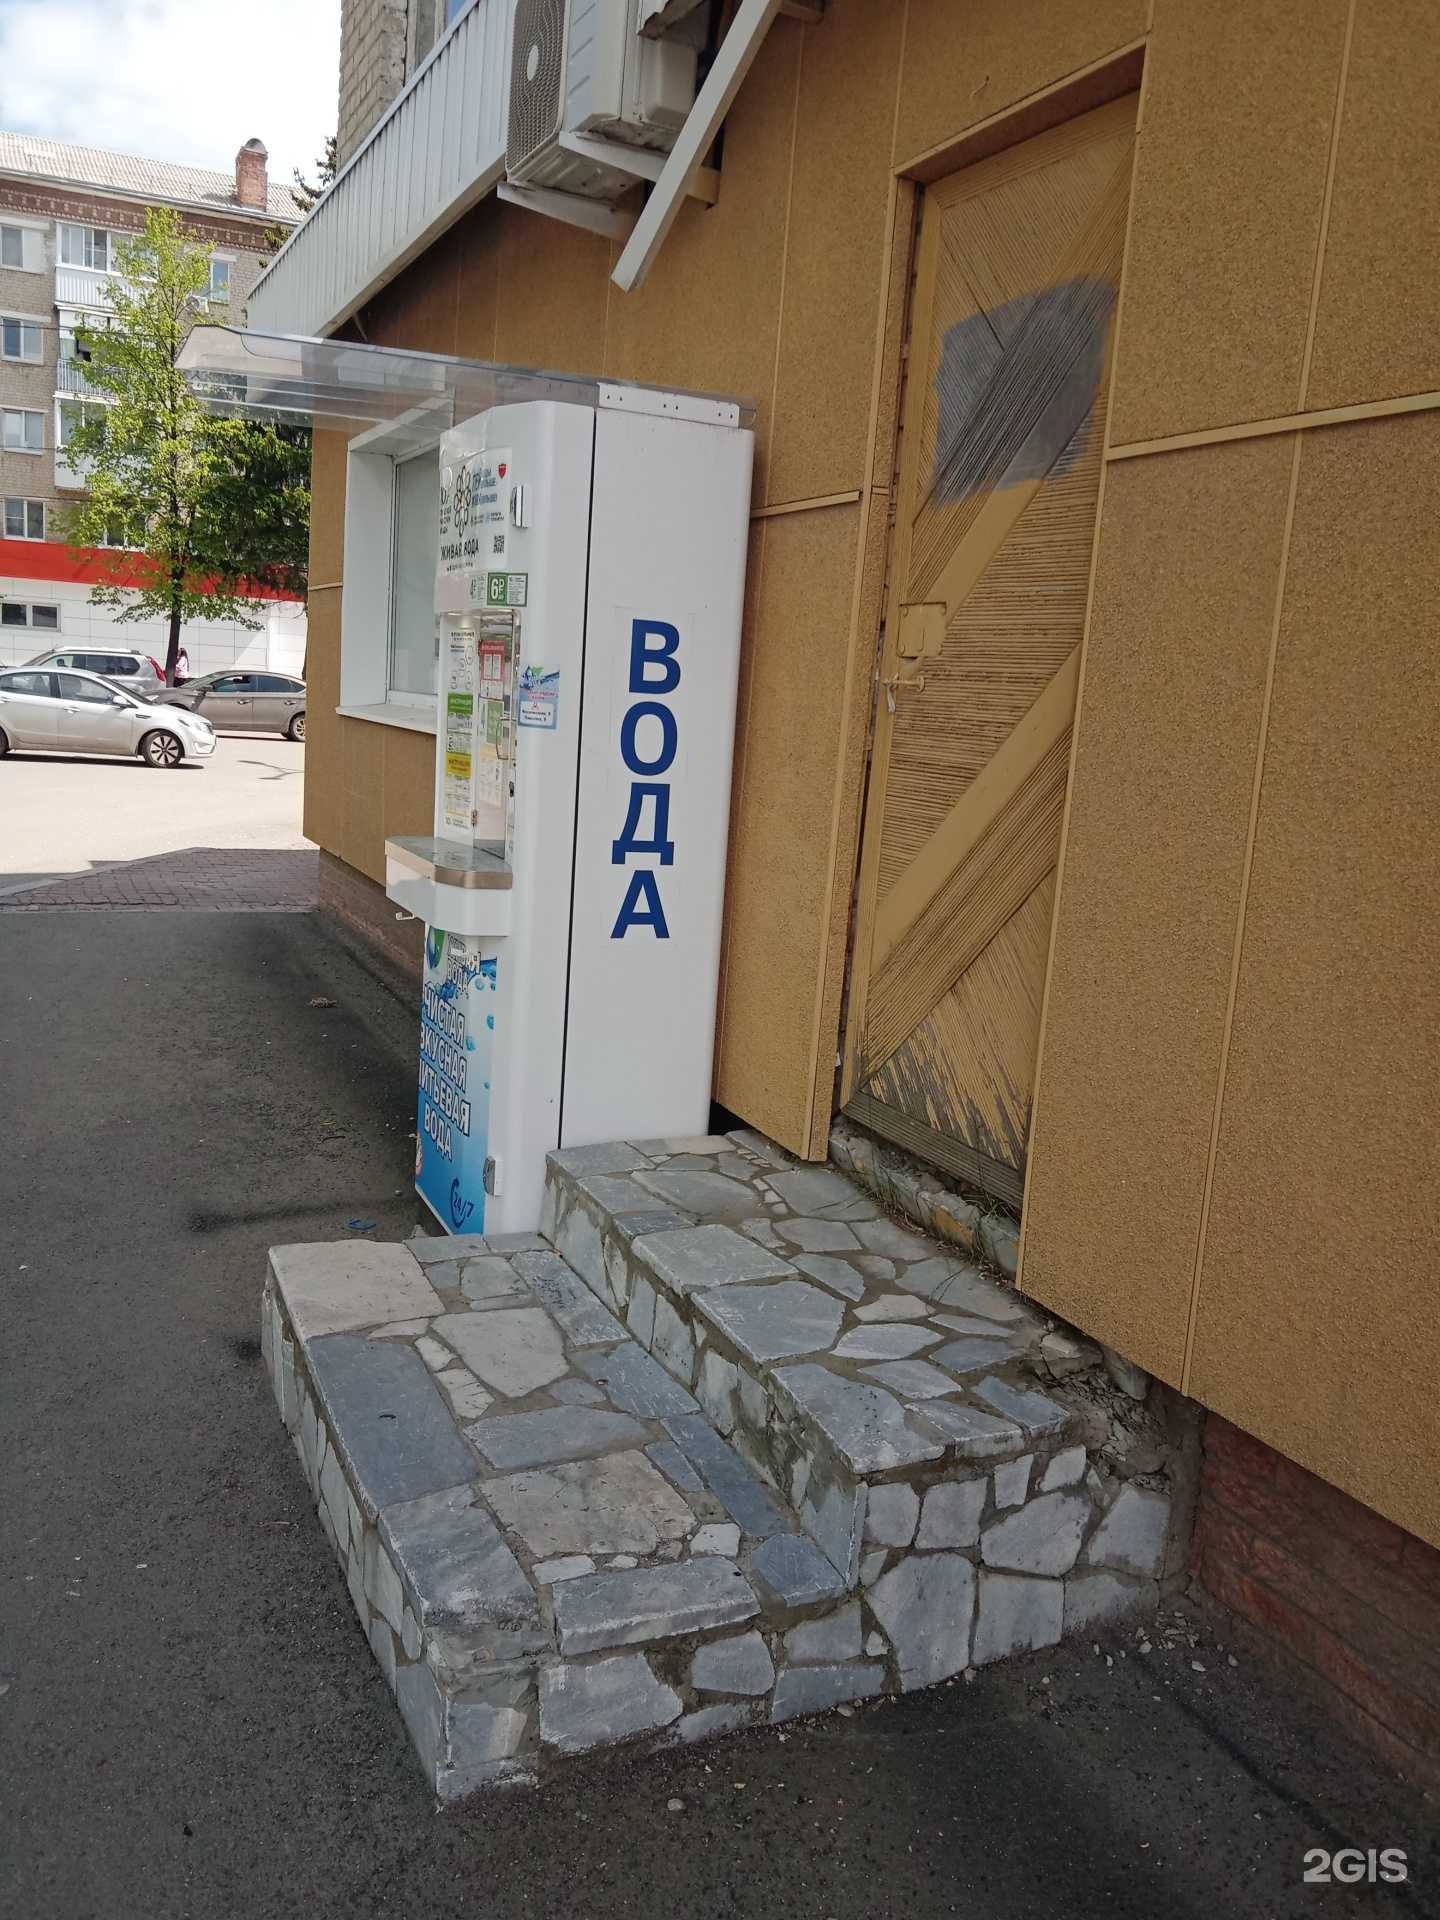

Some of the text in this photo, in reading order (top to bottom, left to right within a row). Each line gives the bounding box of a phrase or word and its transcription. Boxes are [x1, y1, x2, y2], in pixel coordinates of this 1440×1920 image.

[611, 618, 681, 939] ВОДА
[424, 983, 466, 1050] ЧИСТАЯ
[424, 1101, 453, 1162] ВОДА
[453, 1191, 474, 1218] 24/7
